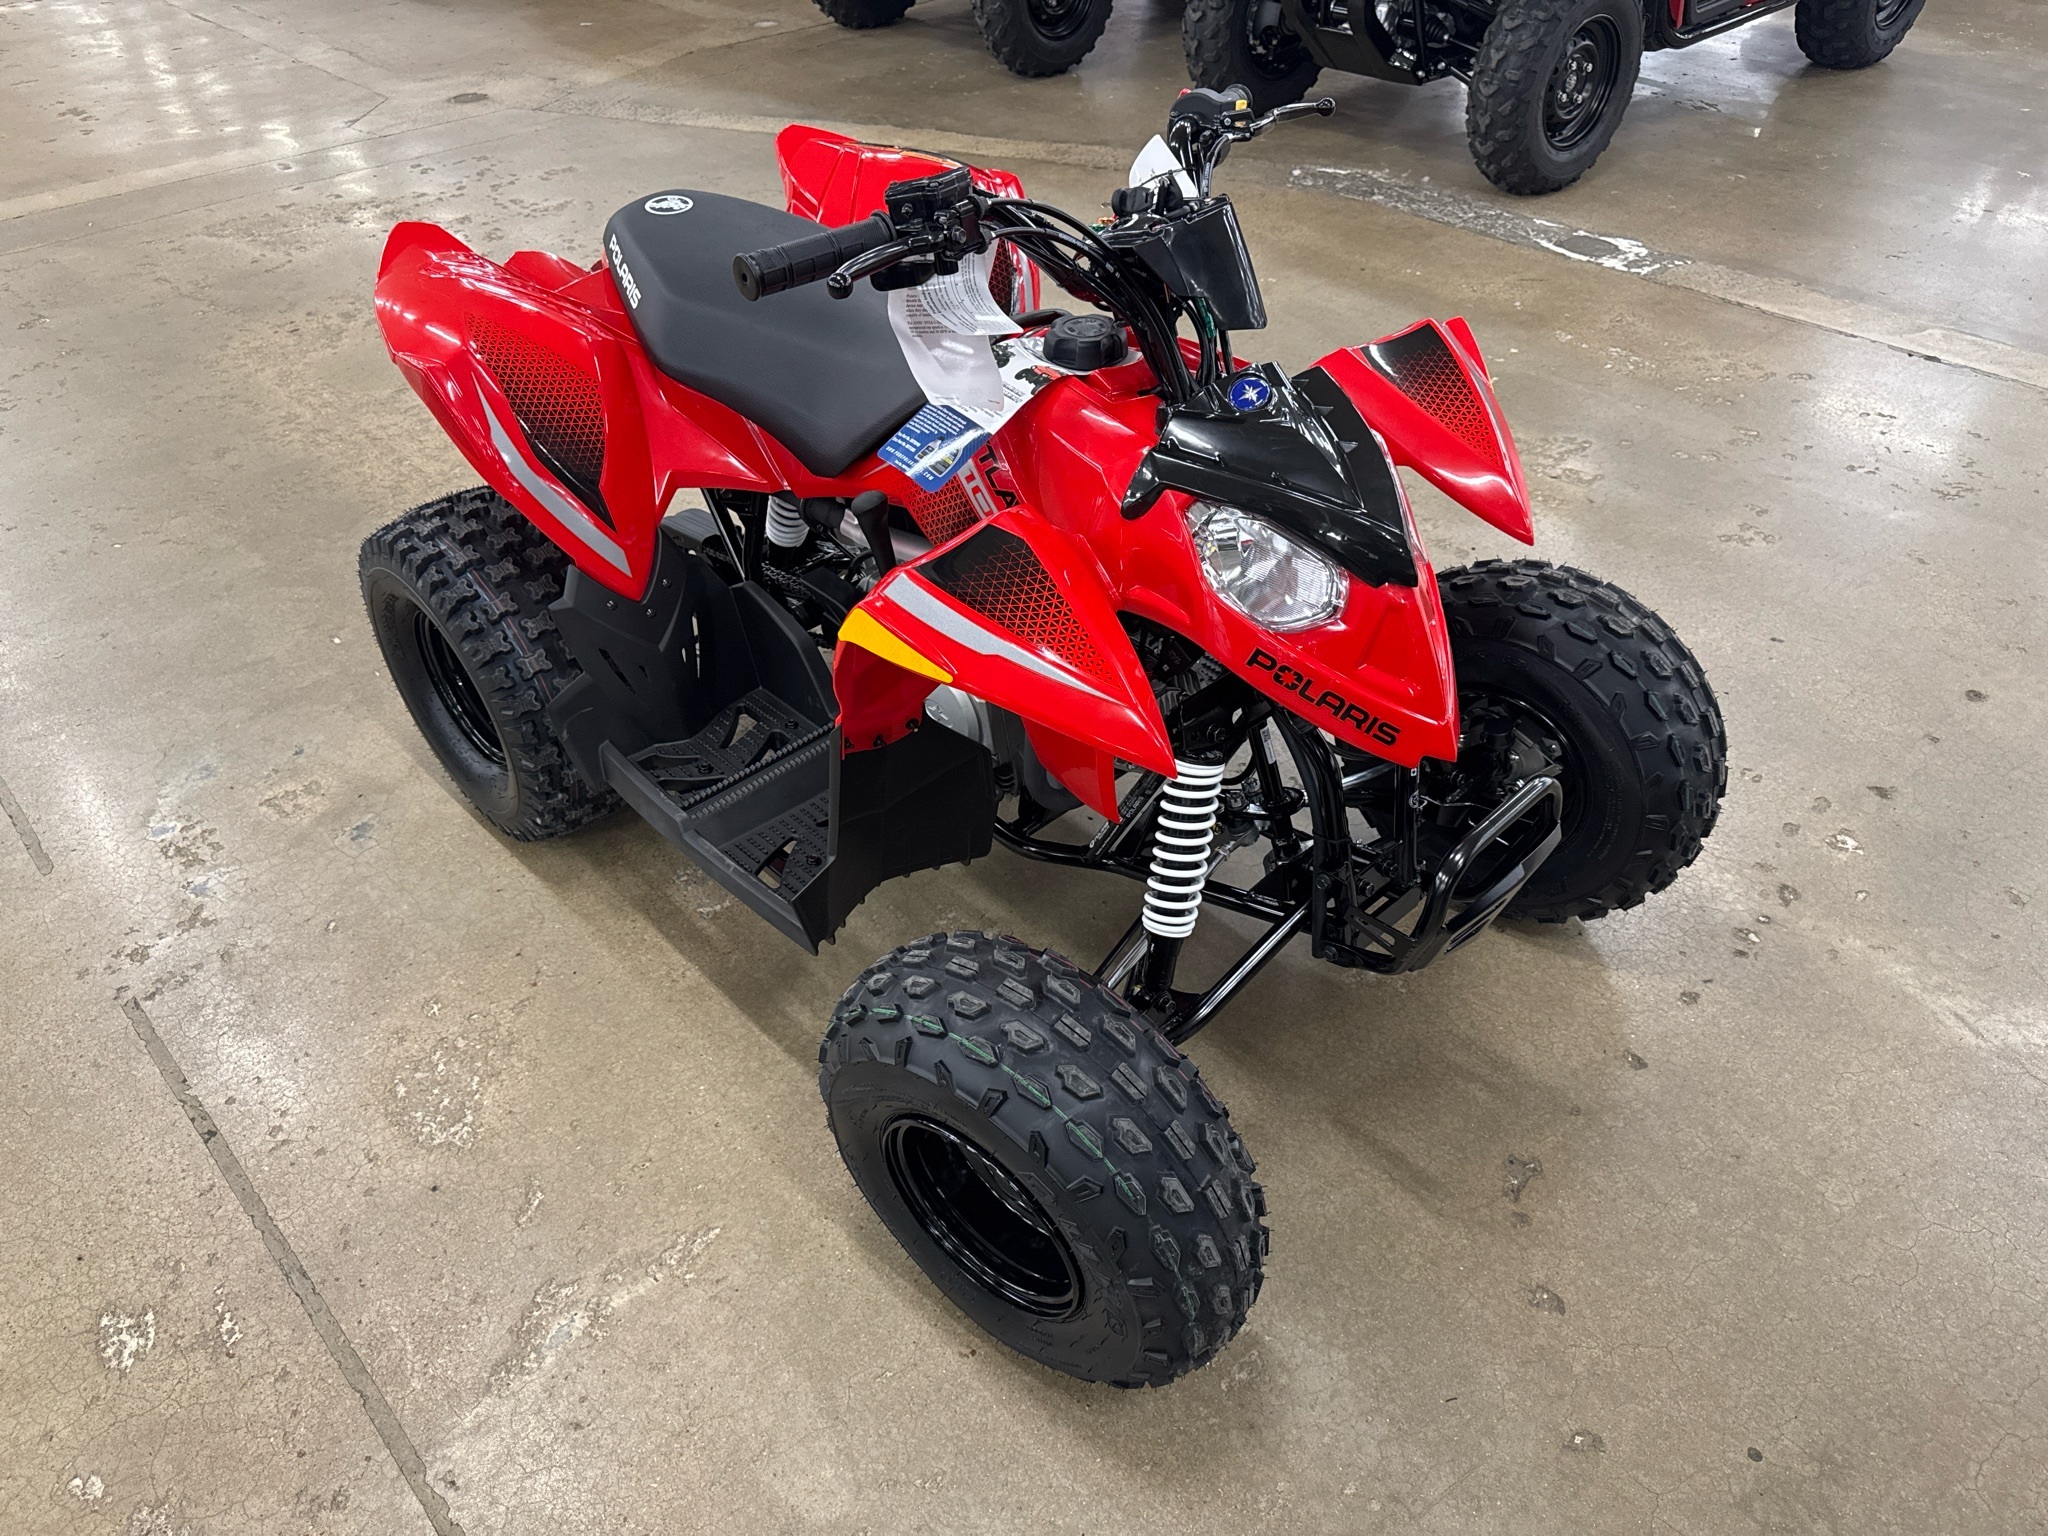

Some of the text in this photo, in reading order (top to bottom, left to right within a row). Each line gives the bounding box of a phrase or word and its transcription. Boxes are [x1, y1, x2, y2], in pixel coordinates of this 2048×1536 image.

[609, 234, 642, 310] POLARIS
[979, 441, 1020, 508] TLA
[1246, 647, 1402, 747] POLARIS
